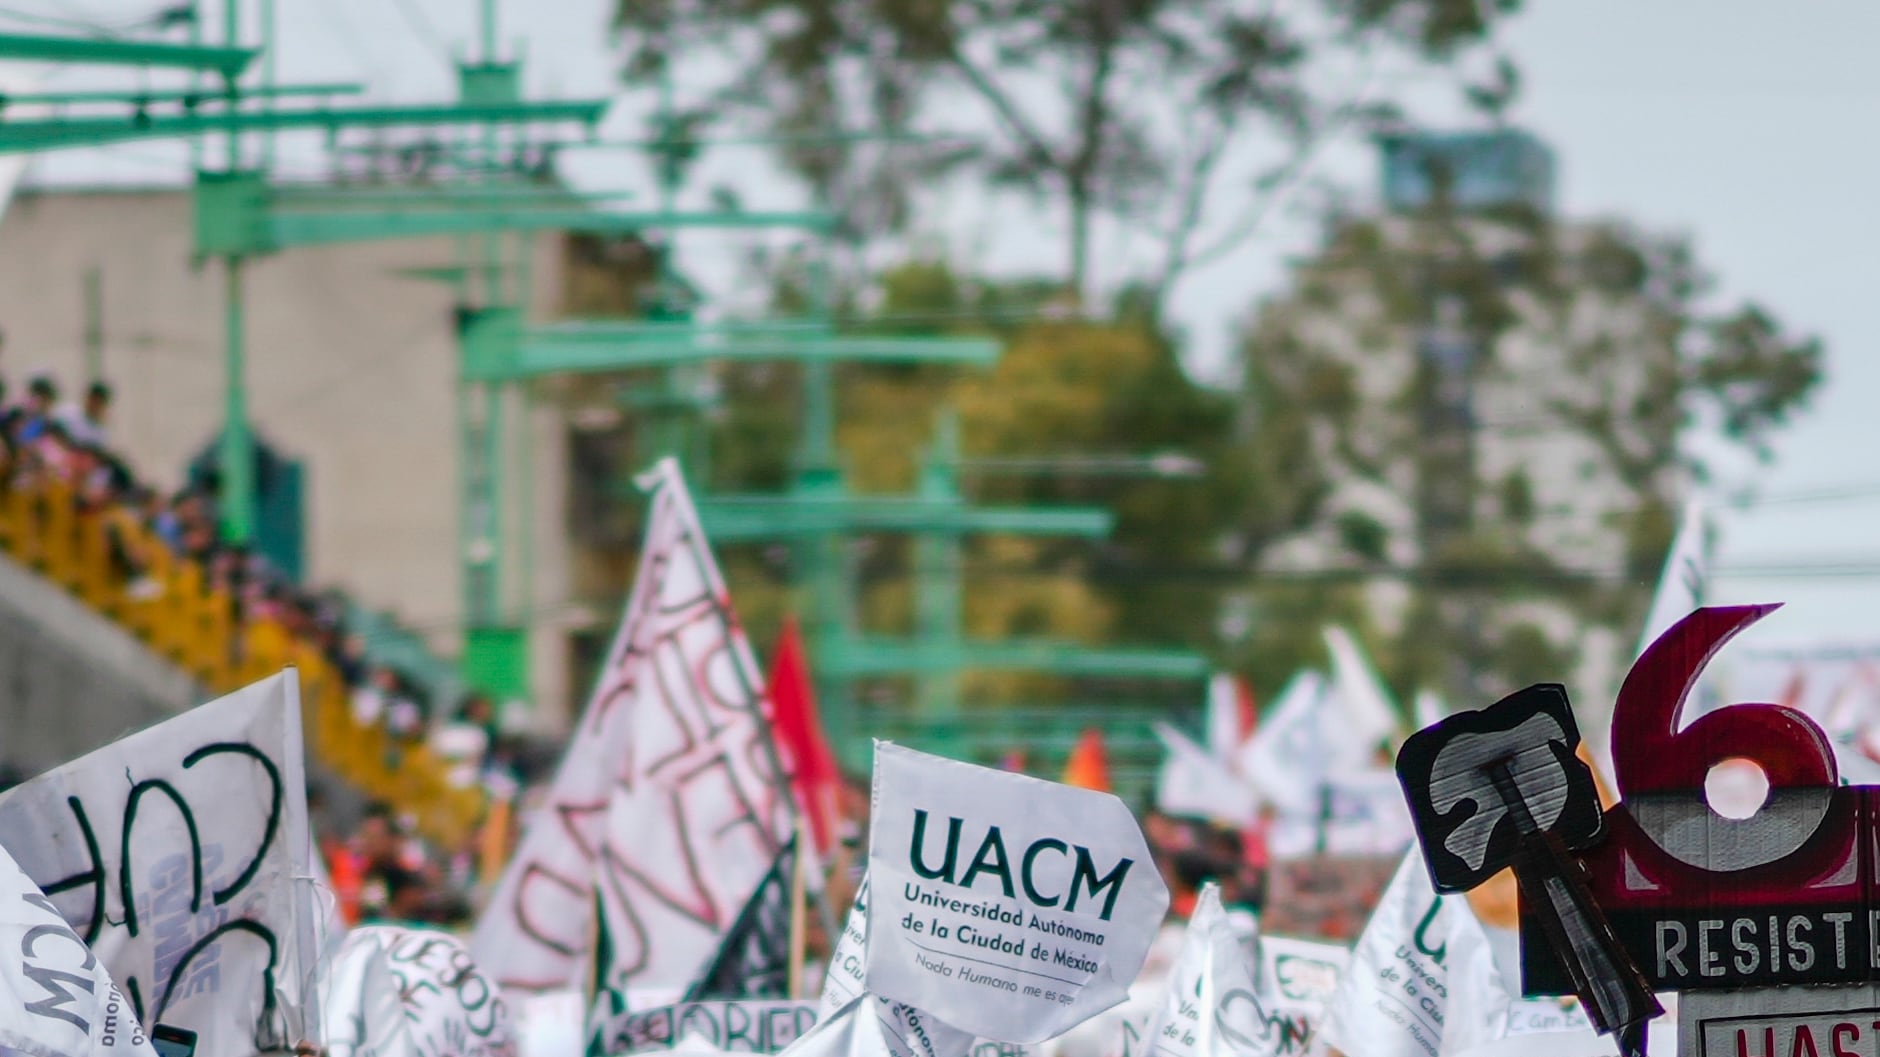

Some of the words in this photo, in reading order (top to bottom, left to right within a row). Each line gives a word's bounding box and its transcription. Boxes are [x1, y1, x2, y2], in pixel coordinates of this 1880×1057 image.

[909, 808, 1135, 921] UACM
[902, 913, 924, 933] de
[930, 919, 949, 938] la
[957, 925, 1025, 956] Ciudad
[1030, 943, 1049, 961] de
[1053, 948, 1098, 974] México
[904, 882, 1023, 927] Universidad
[1028, 914, 1105, 946] Autónoma
[915, 953, 953, 977] Nada
[957, 966, 1018, 992] Humano
[1022, 984, 1042, 997] me
[1045, 990, 1057, 1001] es
